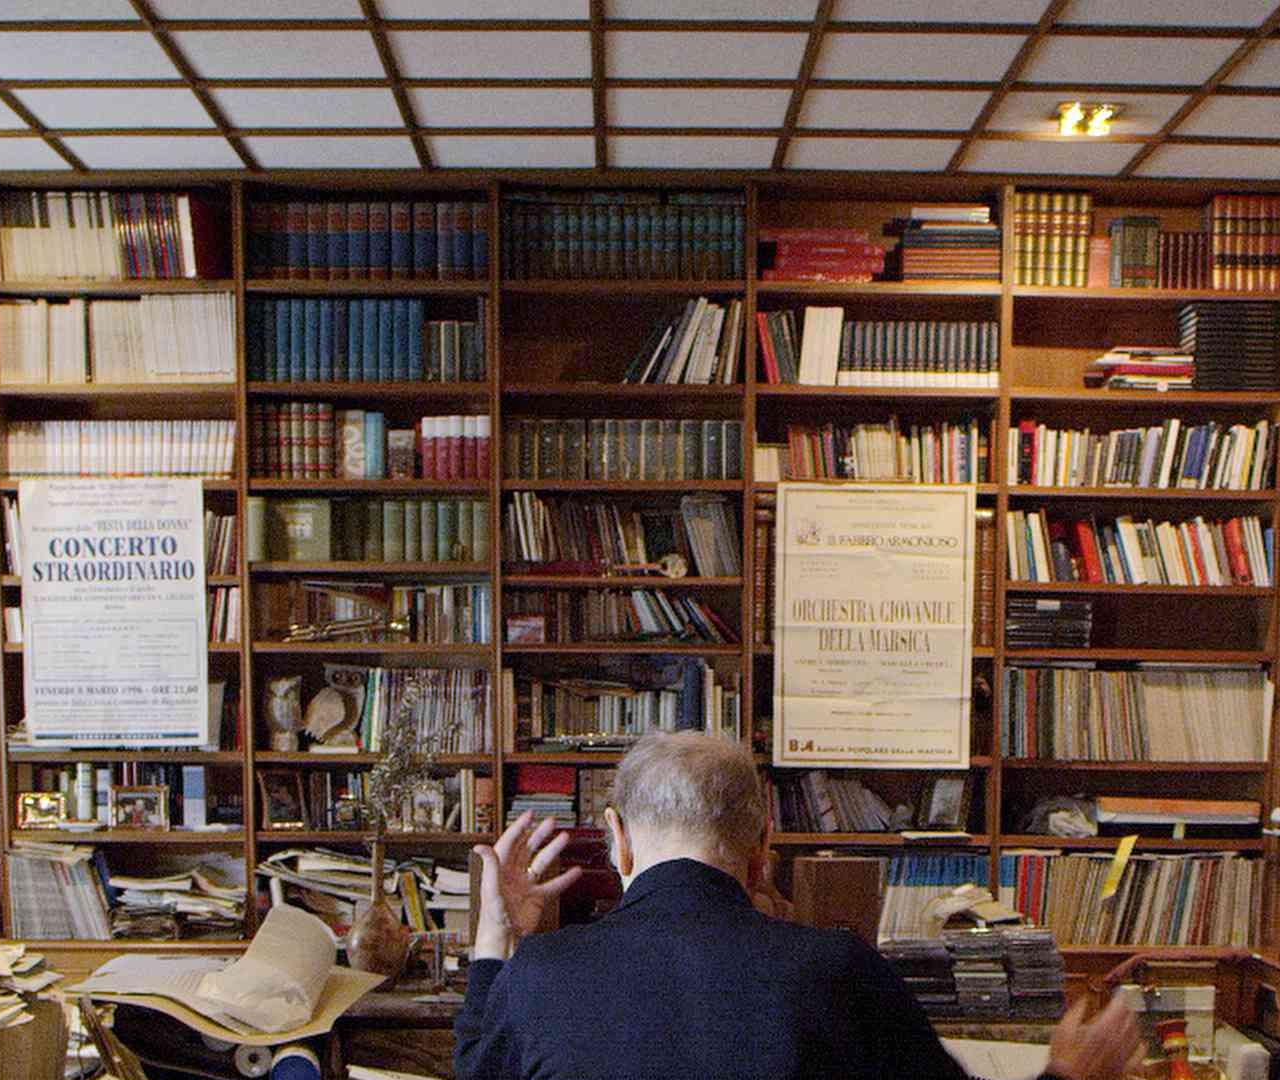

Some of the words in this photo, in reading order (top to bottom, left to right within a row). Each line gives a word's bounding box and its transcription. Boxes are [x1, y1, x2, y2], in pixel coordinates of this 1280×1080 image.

[49, 535, 177, 558] CONCERTO
[32, 559, 195, 583] STRAORDINARIO
[792, 599, 875, 622] ORCHESTRA
[879, 599, 955, 625] GIOVANILE
[818, 628, 865, 651] DELLA
[869, 628, 931, 653] MARSICA
